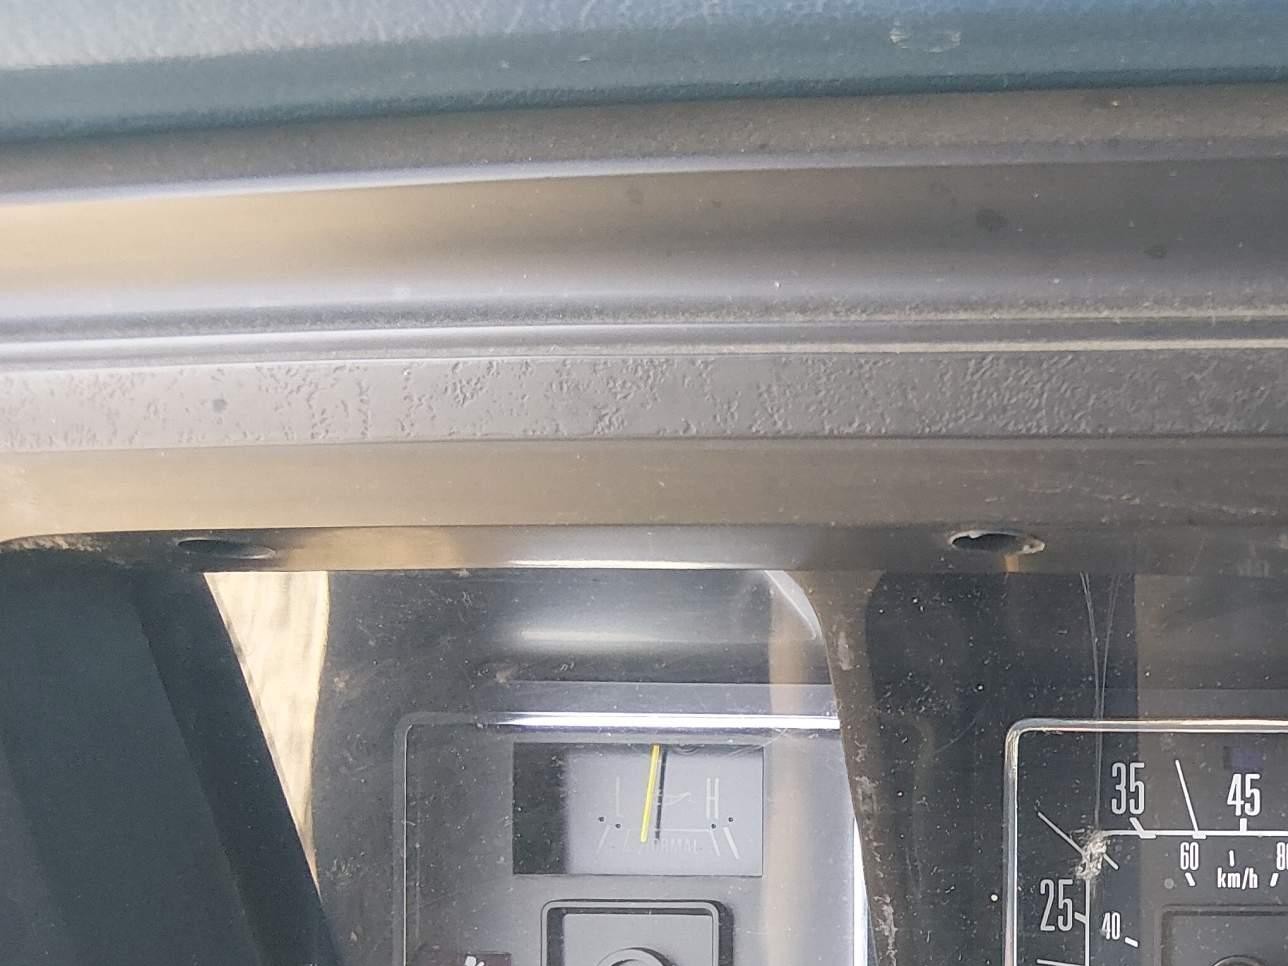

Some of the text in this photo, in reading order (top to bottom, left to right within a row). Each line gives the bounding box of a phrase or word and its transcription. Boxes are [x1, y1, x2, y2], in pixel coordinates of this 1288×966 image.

[1111, 763, 1145, 814] 35
[1227, 774, 1261, 816] 45
[1180, 842, 1199, 870] 60
[1217, 868, 1258, 889] km/h
[1040, 879, 1073, 931] 25
[1101, 912, 1121, 940] 40
